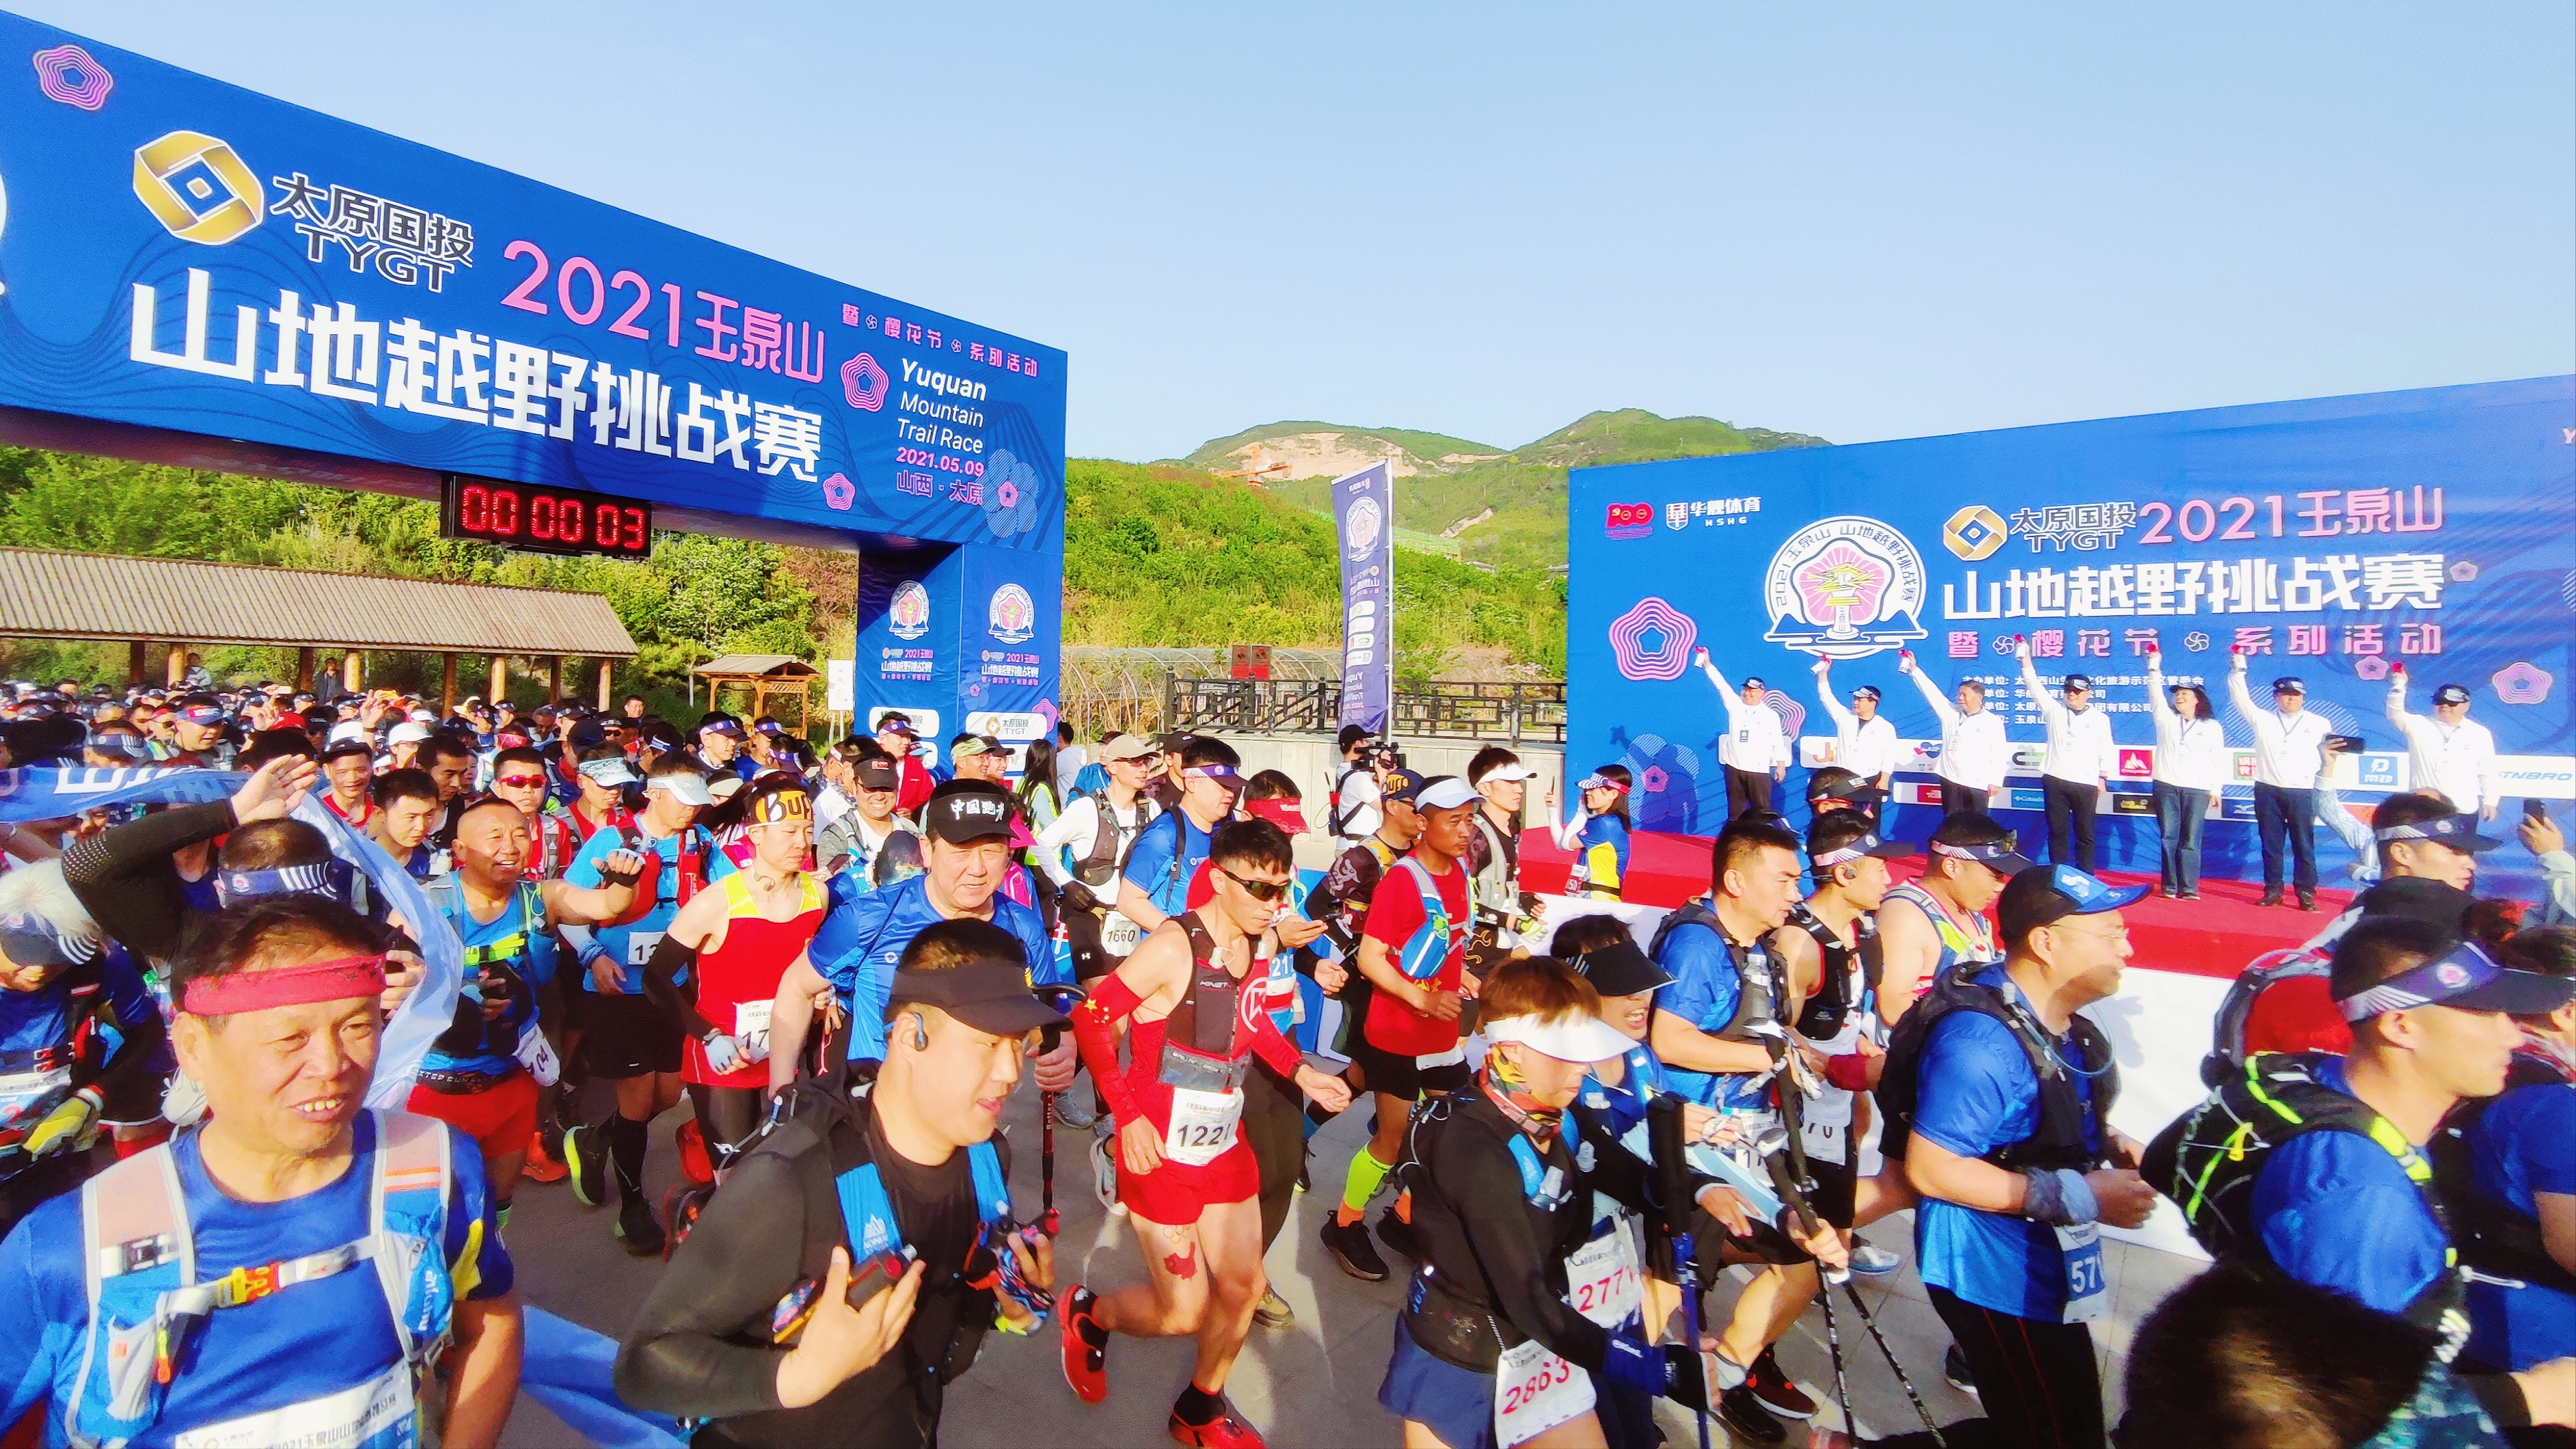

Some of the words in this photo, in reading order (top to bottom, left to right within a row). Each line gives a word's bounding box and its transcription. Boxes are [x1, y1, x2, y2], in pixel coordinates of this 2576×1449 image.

[270, 172, 474, 268] 太原国投
[295, 222, 455, 294] TYGT
[884, 316, 942, 349] 樱花节
[970, 342, 1038, 377] 系列活动
[130, 267, 822, 483] 山地越野挑战赛
[901, 357, 986, 401] Yuquan
[899, 391, 984, 428] Mountain
[897, 418, 938, 445] Trail
[940, 427, 984, 454] Race
[895, 446, 986, 476] 2021.05.09
[461, 486, 517, 534] 00
[530, 496, 582, 541] 00
[596, 504, 644, 550] 03
[2009, 502, 2137, 535] 太原国投
[2024, 529, 2124, 553] TYGT
[1943, 552, 2445, 621] 山地越野挑战赛
[1948, 630, 1979, 658] 暨
[2032, 628, 2159, 658] 樱花节
[2231, 623, 2443, 656] 系列活动
[1107, 930, 1136, 943] 1660
[1502, 1355, 1571, 1415] 2863
